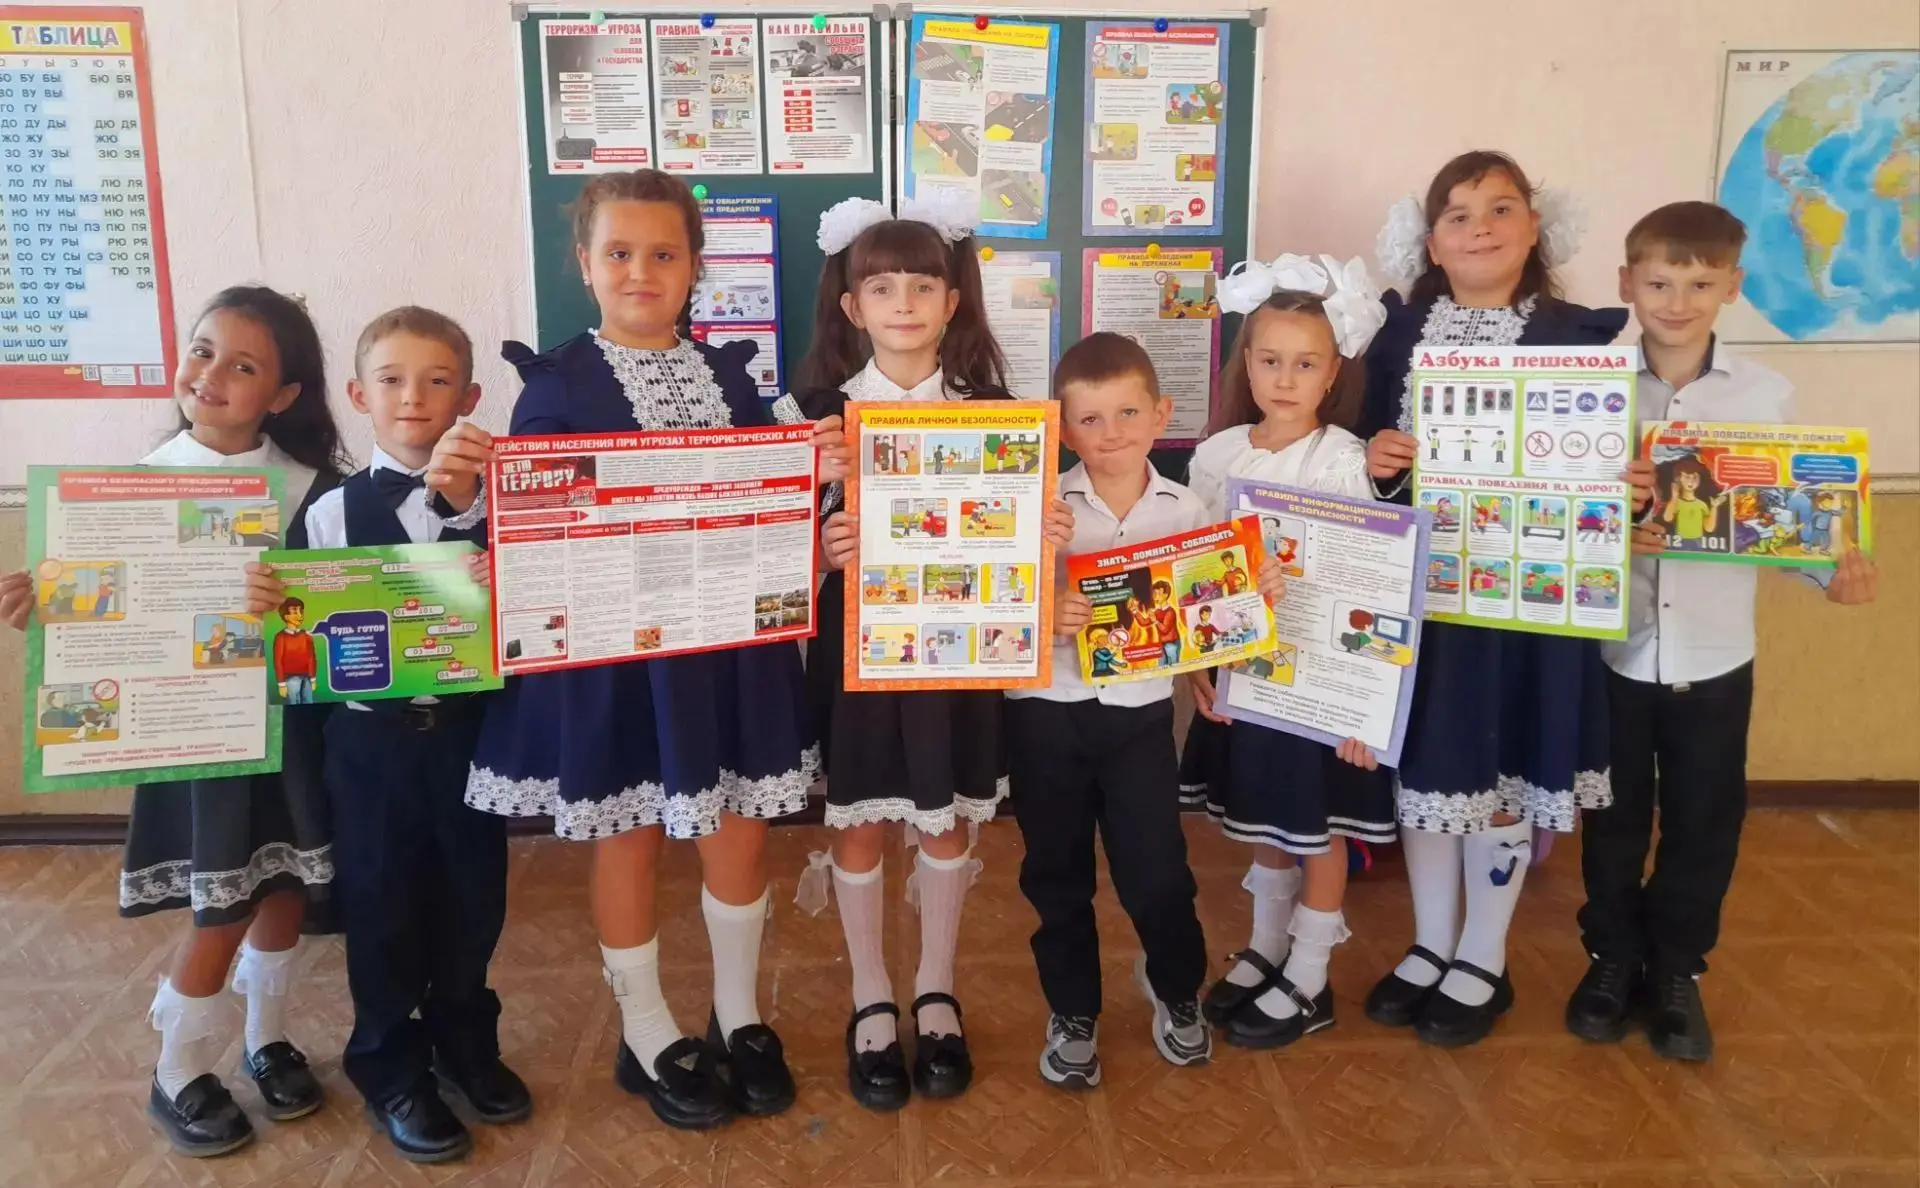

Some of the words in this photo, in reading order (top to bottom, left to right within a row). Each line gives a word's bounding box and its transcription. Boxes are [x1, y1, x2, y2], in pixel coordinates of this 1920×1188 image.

[545, 24, 598, 35] ТЕРРОРИЗМ
[608, 24, 641, 34] УГРОЗА
[656, 25, 700, 35] ПРАВИЛА
[769, 25, 790, 34] КАК
[11, 25, 119, 47] ТАБЛИЦА
[45, 59, 55, 67] Ы
[71, 59, 78, 67] Э
[93, 59, 103, 67] Ю
[1736, 60, 1790, 72] МИР
[20, 74, 35, 82] БУ
[43, 74, 61, 82] БЫ
[90, 75, 109, 83] БЮ
[117, 75, 132, 83] БЯ
[22, 89, 36, 98] ВУ
[44, 89, 63, 98] ВЫ
[118, 90, 133, 98] ВЯ
[24, 104, 37, 113] ГУ
[1, 120, 18, 129] ДО
[25, 120, 40, 129] ДУ
[47, 120, 66, 129] ДЫ
[95, 120, 115, 129] ДЮ
[121, 120, 137, 129] ДЯ
[2, 135, 20, 143] ЖО
[26, 135, 43, 143] ЖУ
[96, 135, 118, 143] ЖЮ
[5, 150, 21, 158] ЗО
[29, 150, 43, 158] ЗУ
[51, 150, 69, 158] ЗЫ
[99, 150, 118, 158] ЗЮ
[125, 150, 140, 158] ЗЯ
[7, 164, 22, 173] КО
[31, 164, 45, 173] КУ
[8, 179, 24, 188] ЛО
[33, 179, 47, 188] ЛУ
[55, 179, 72, 188] ЛЫ
[101, 179, 121, 188] ЛЮ
[128, 179, 143, 188] ЛЯ
[9, 194, 27, 202] МО
[33, 194, 50, 203] МУ
[55, 194, 75, 202] МЫ
[80, 194, 98, 202] МЭ
[102, 194, 123, 202] МЮ
[128, 194, 145, 202] МЯ
[12, 209, 28, 217] НО
[36, 209, 50, 218] НУ
[58, 209, 76, 217] НЫ
[105, 209, 124, 217] НЮ
[130, 209, 145, 217] НЯ
[14, 224, 30, 232] ПО
[38, 224, 52, 232] ПУ
[60, 224, 77, 232] ПЫ
[84, 224, 100, 232] ПЭ
[107, 224, 125, 232] ПЮ
[132, 224, 147, 232] ПЯ
[40, 239, 54, 247] РУ
[17, 253, 33, 261] СО
[41, 253, 55, 262] СУ
[63, 253, 80, 261] СЫ
[87, 253, 103, 261] СЭ
[109, 253, 128, 261] СЮ
[135, 253, 149, 261] СЯ
[43, 268, 56, 276] ТУ
[112, 267, 129, 275] ТЮ
[136, 267, 150, 275] ТЯ
[20, 282, 37, 290] ФО
[44, 282, 59, 290] ФУ
[65, 282, 85, 290] ФЫ
[137, 281, 153, 290] ФЯ
[1, 297, 15, 305] ХИ
[23, 296, 38, 304] ХО
[47, 296, 61, 305] ХУ
[1, 311, 18, 320] ЦИ
[24, 311, 40, 319] ЦО
[48, 311, 62, 320] ЦУ
[69, 311, 88, 319] ЦЫ
[3, 325, 18, 333] ЧИ
[26, 325, 42, 333] ЧО
[50, 325, 64, 333] ЧУ
[26, 339, 45, 347] ШО
[50, 339, 67, 348] ШУ
[5, 354, 24, 363] ЩИ
[28, 353, 47, 362] ЩО
[52, 353, 69, 362] ЩУ
[1419, 351, 1500, 369] Азбука
[1512, 353, 1627, 369] пешехода
[870, 416, 915, 425] ПРАВИЛА
[917, 415, 958, 425] ЛИЧНОЙ
[961, 415, 1037, 425] БЕЗОПАСНОСТИ
[1663, 429, 1709, 438] ПРАВИЛА
[1712, 431, 1775, 440] ПОВЕДЕНИЯ
[1778, 432, 1799, 440] ПРИ
[1803, 434, 1846, 443] ПОЖАРЕ
[495, 441, 549, 452] ДЕЙСТВИЯ
[553, 439, 614, 450] НАСЕЛЕНИЯ
[616, 438, 637, 447] ПРИ
[640, 437, 685, 447] УГРОЗАХ
[688, 432, 784, 445] ТЕРРОРИСТИЧЕСКИХ
[787, 430, 813, 439] АКТОВ
[500, 469, 574, 491] ТЕРРОРУ
[1420, 476, 1473, 486] ПРАВИЛА
[1478, 479, 1548, 490] ПОВЕДЕНИЯ
[1554, 483, 1569, 492] НА
[1575, 484, 1623, 493] ДОРОГЕ
[1255, 489, 1300, 502] ПРАВИЛА
[1302, 497, 1400, 520] ИНФОРМАЦИОННОЙ
[1289, 504, 1366, 524] БЕЗОПАСНОСТИ
[1182, 529, 1235, 549] СОБЛЮДАТЬ
[1656, 535, 1682, 547] 12
[1701, 536, 1725, 549] 101
